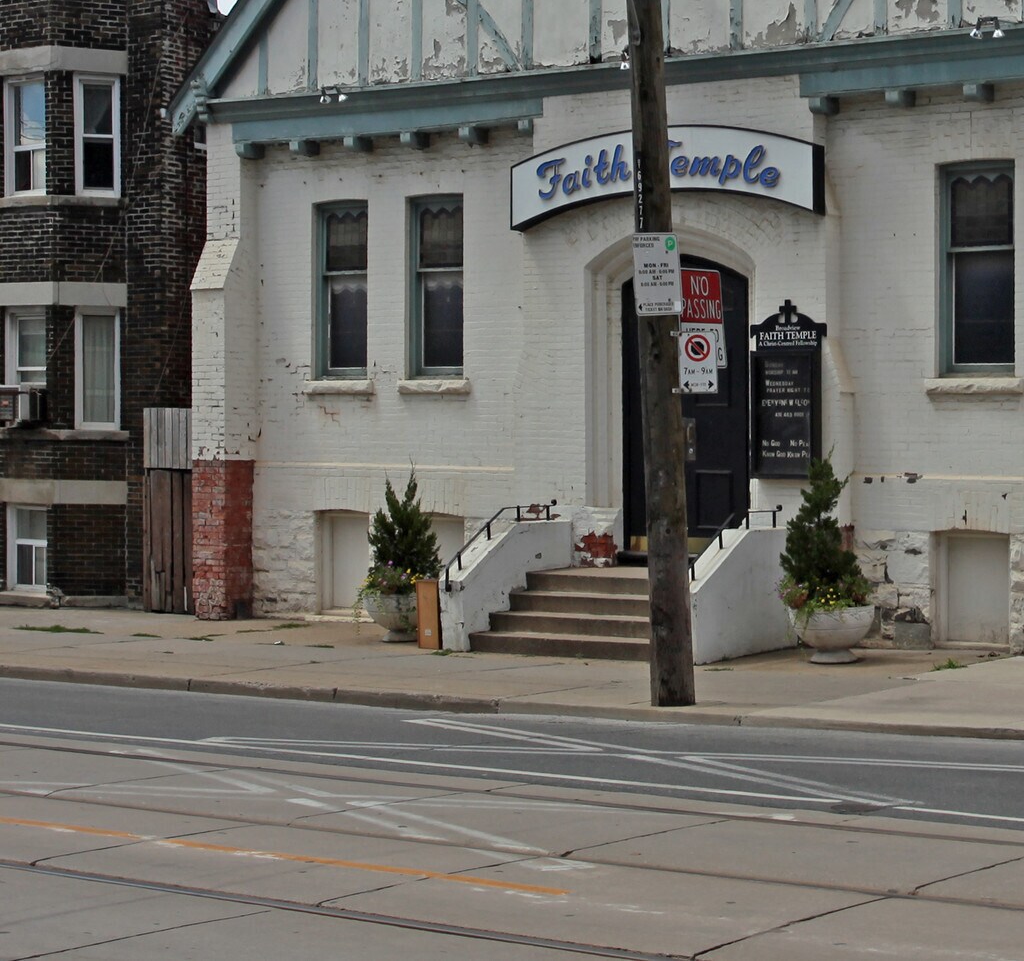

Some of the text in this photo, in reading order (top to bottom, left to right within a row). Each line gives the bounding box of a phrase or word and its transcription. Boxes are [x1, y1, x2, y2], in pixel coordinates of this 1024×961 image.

[537, 144, 632, 199] Faith
[690, 276, 709, 296] NO
[681, 299, 721, 320] PASSING
[759, 330, 817, 340] FAITH TEMPLE
